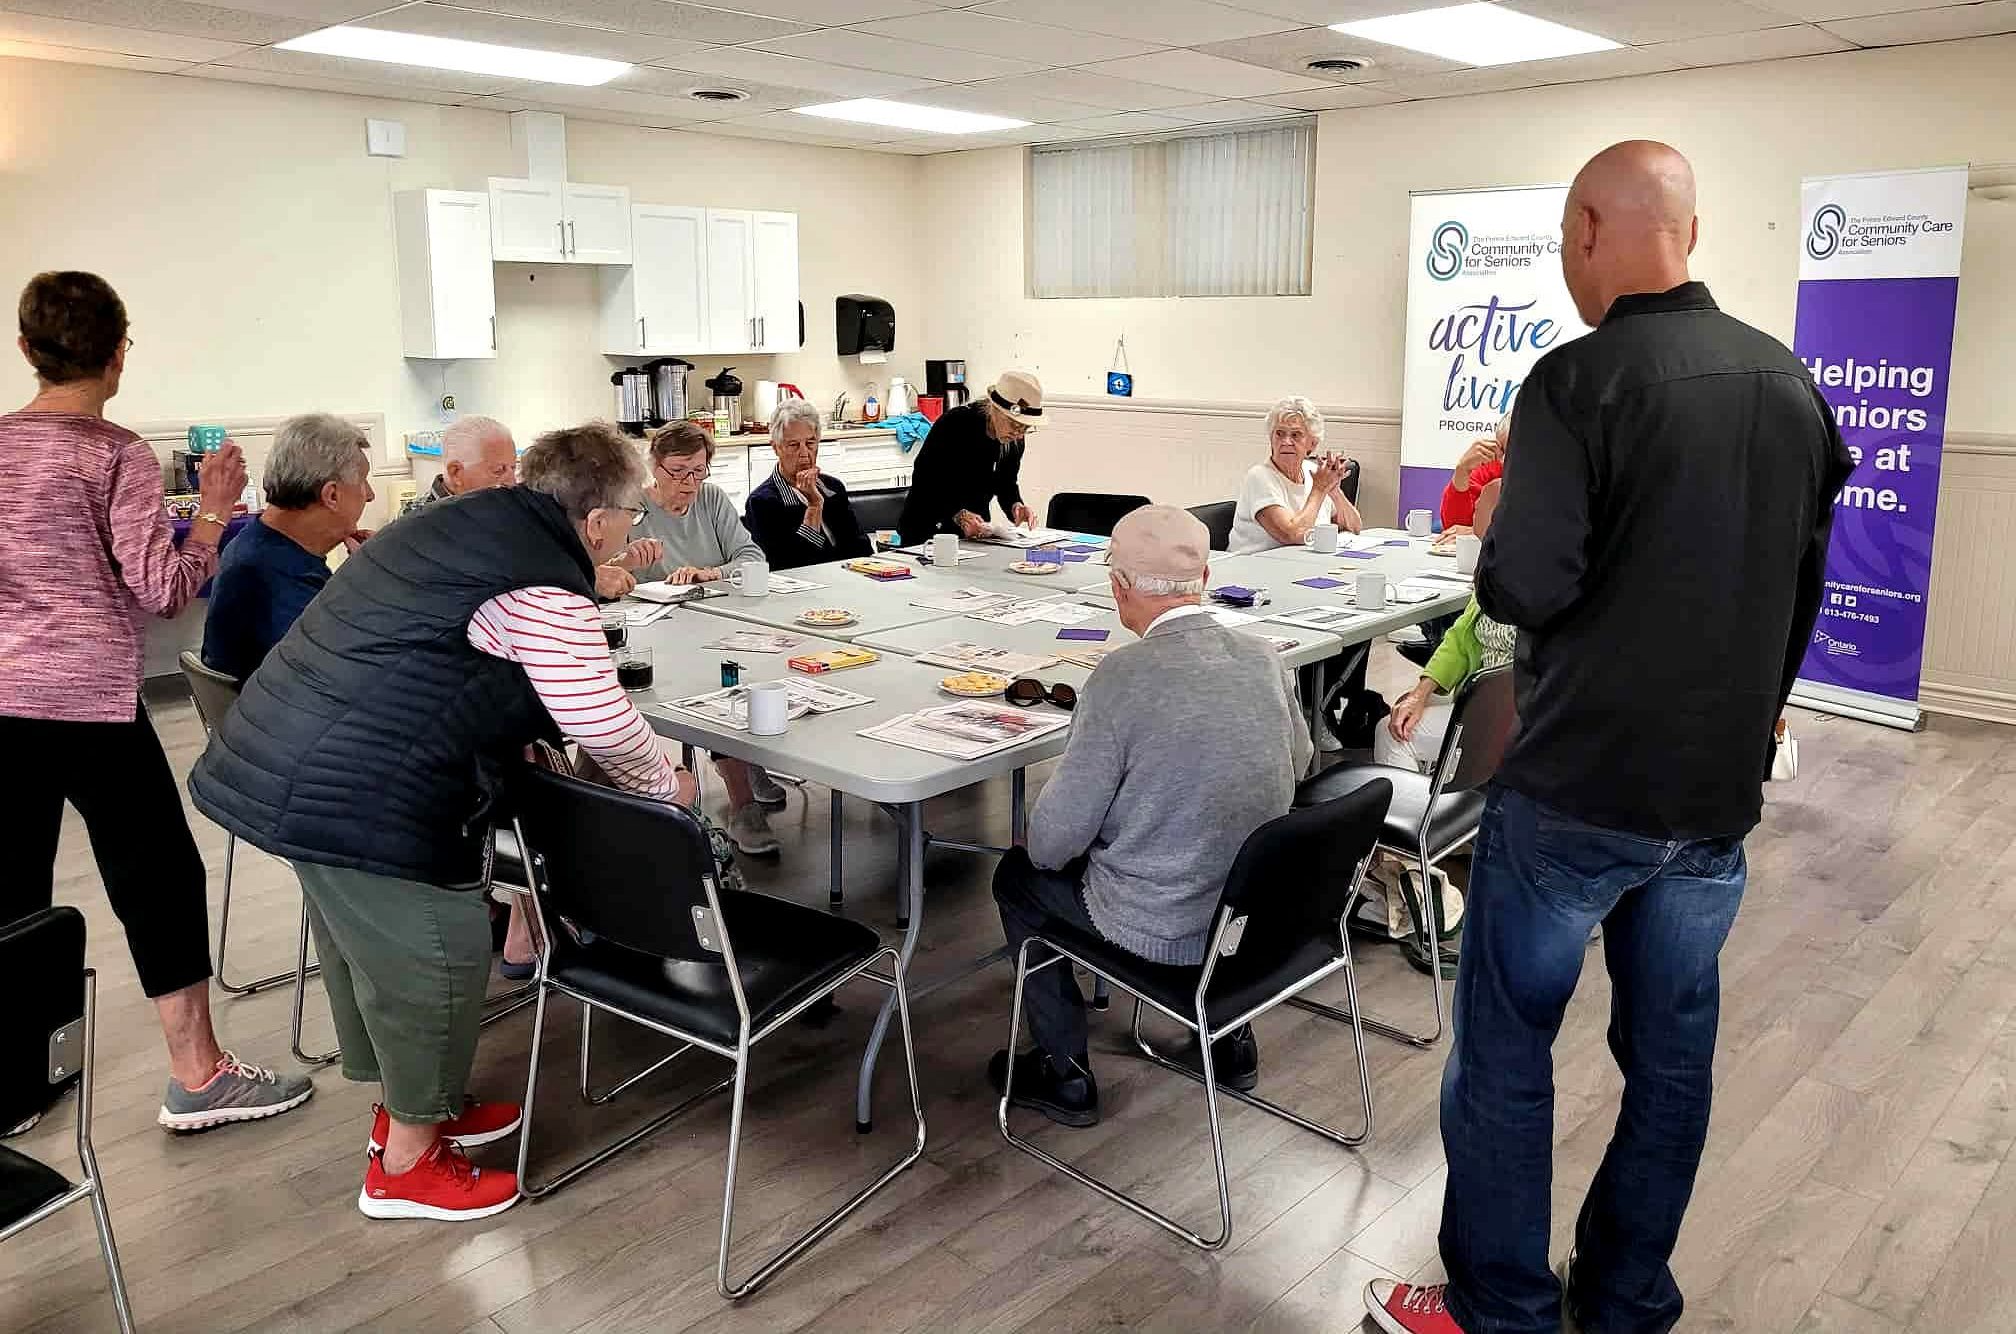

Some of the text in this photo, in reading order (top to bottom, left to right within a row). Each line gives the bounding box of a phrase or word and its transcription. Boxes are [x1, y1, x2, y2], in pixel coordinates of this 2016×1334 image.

[1883, 214, 1905, 222] Edward
[1848, 220, 1953, 236] Community Care
[1505, 233, 1529, 241] Edward
[1842, 235, 1906, 248] for Seniors
[1471, 243, 1544, 259] Community
[1465, 255, 1531, 269] for Seniors
[1429, 295, 1563, 366] active
[1801, 357, 1934, 398] Helping
[1875, 444, 1911, 472] at
[1828, 638, 1857, 651] Ontario
